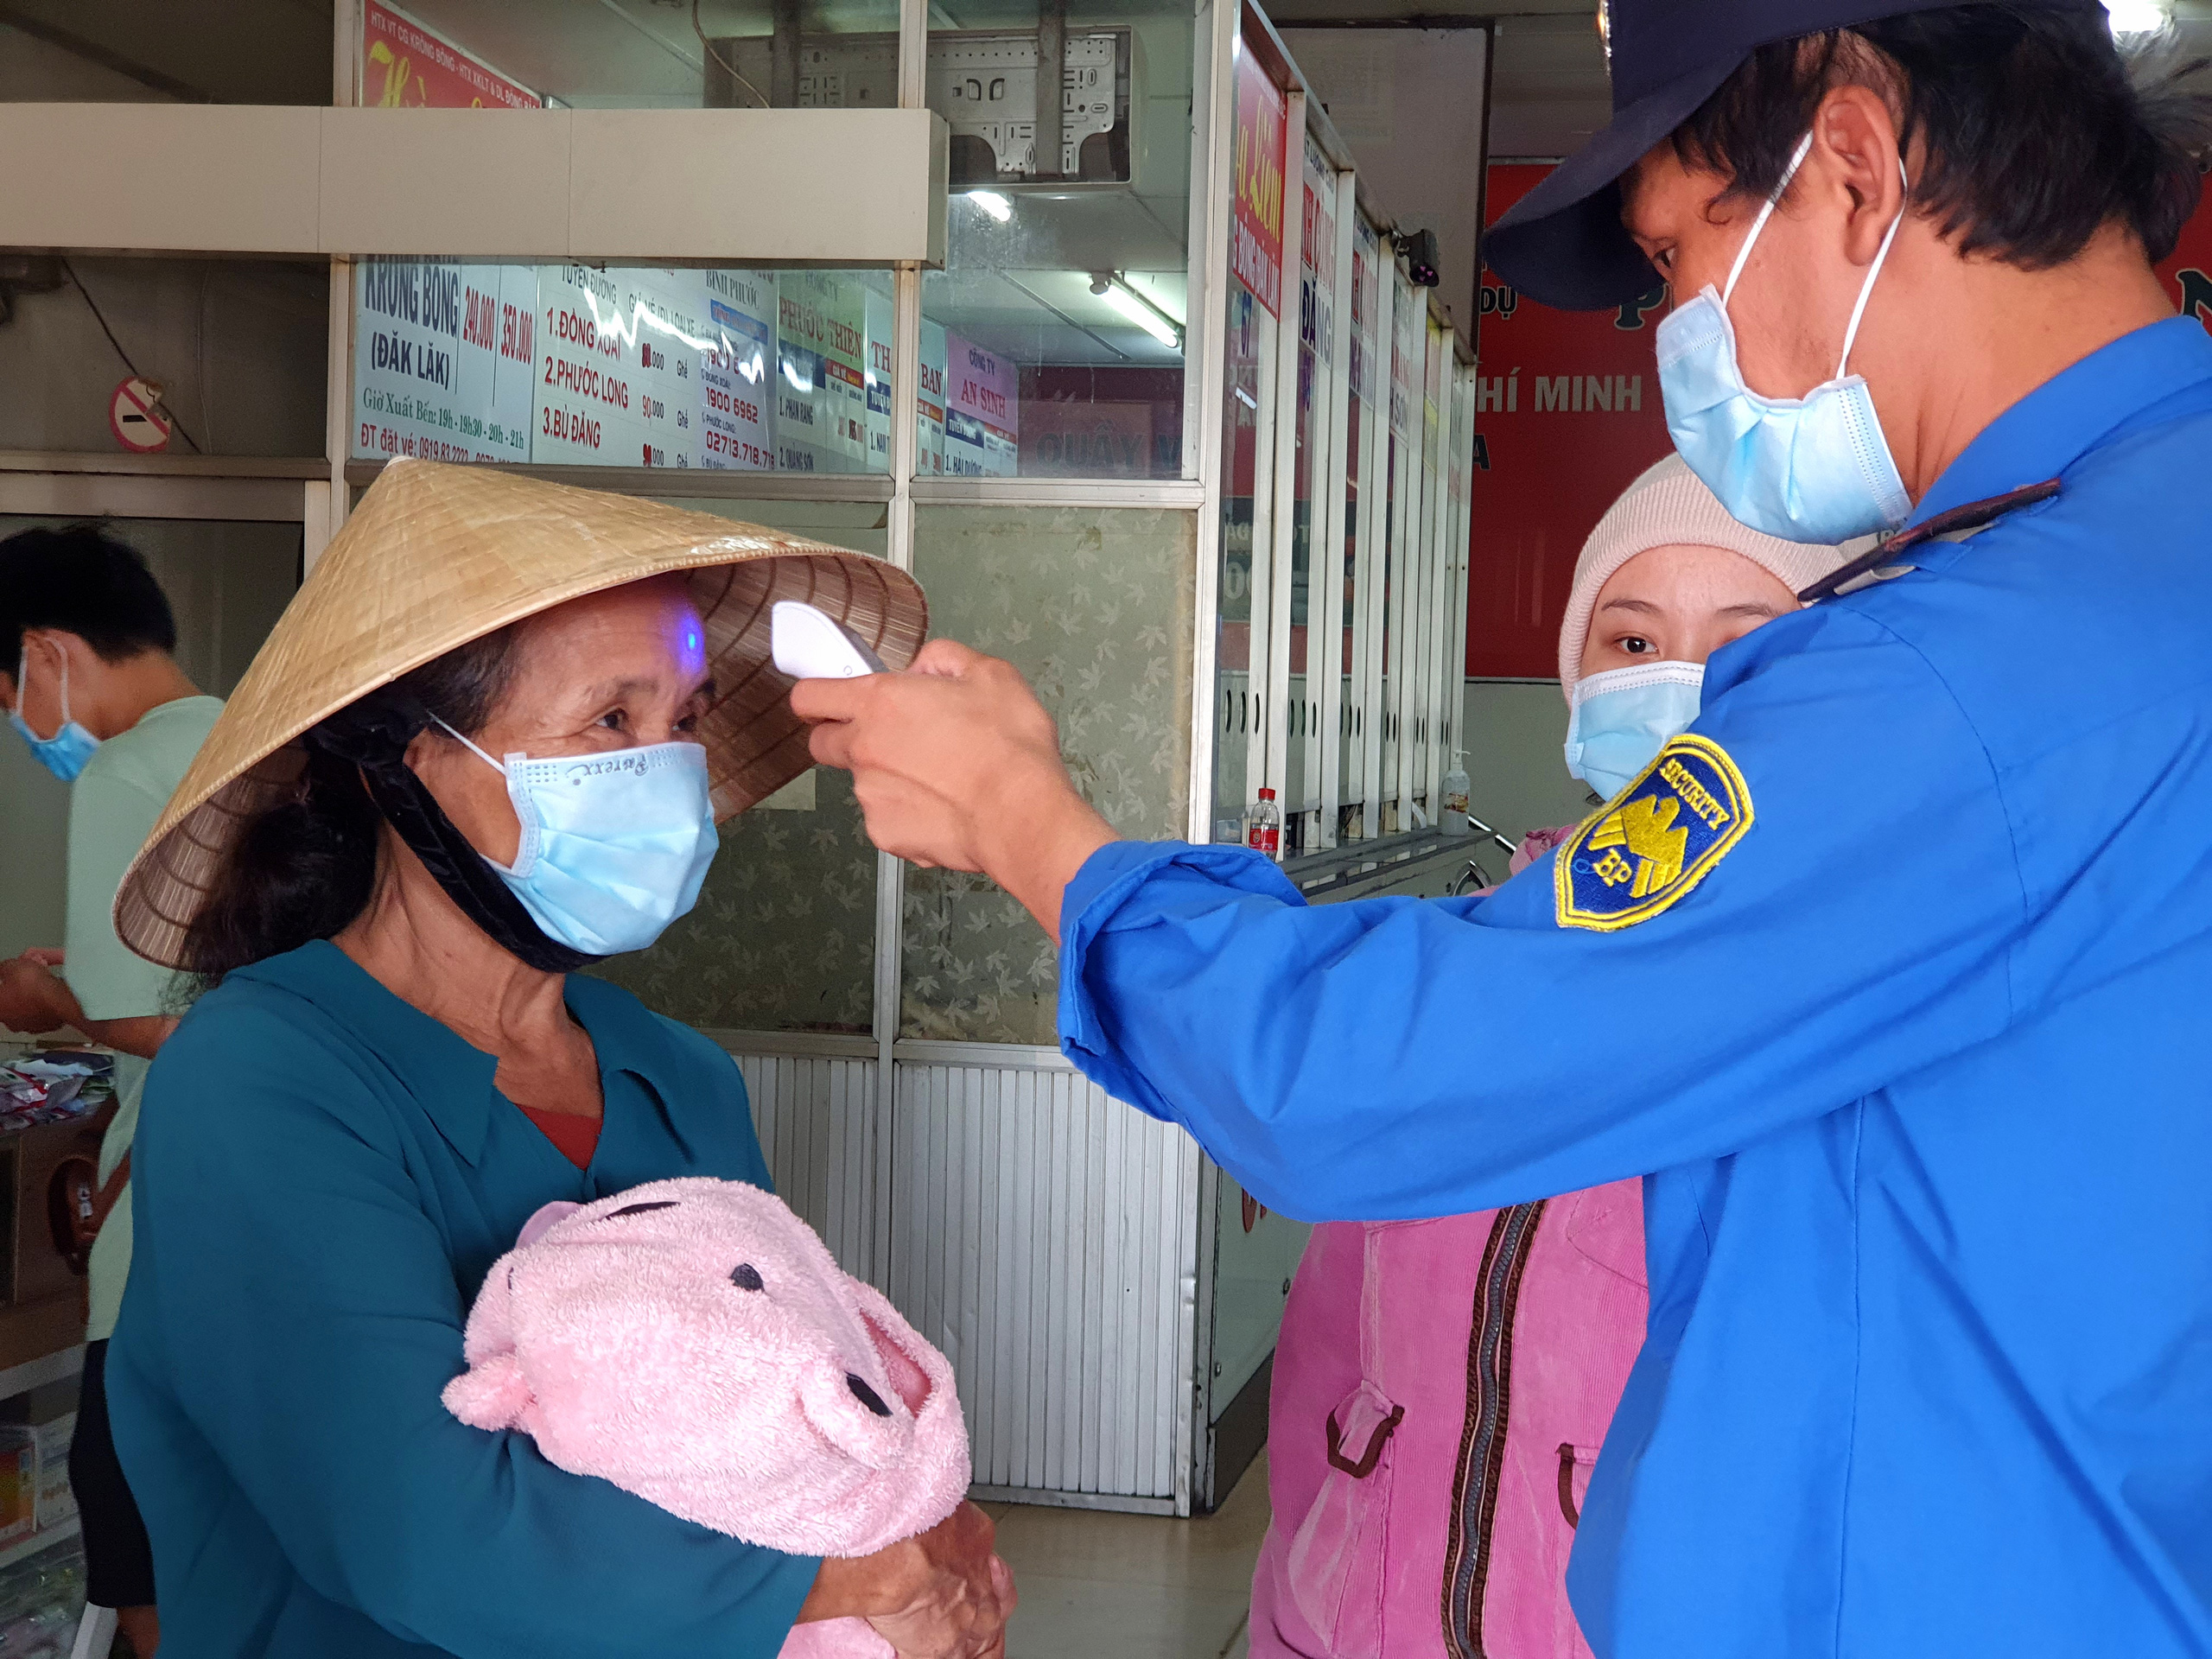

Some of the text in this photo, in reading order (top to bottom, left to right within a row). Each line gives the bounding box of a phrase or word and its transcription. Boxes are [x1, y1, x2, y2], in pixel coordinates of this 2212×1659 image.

[463, 285, 533, 366] 240.000 350.000
[969, 347, 986, 374] CÔNG
[544, 356, 599, 398] 2.PHƯỚC
[602, 374, 628, 409] LONG
[642, 395, 664, 419] 90.000
[706, 386, 758, 424] 1900 6962
[961, 378, 1007, 419] AN SINH
[1478, 366, 1642, 412] HÍ MINH
[361, 423, 377, 448] ĐT
[380, 427, 398, 457] đặt
[401, 432, 417, 456] vé:
[363, 387, 384, 410] Giờ
[385, 392, 413, 418] Xuất
[416, 400, 436, 424] Bến:
[438, 408, 454, 429] 19h
[460, 415, 482, 436] 19h30
[488, 423, 504, 444] 20h
[510, 429, 524, 449] 21h
[543, 404, 569, 440] 3.BÙ
[571, 410, 601, 448] ĐĂNG
[1660, 758, 1730, 830] SECURITY
[1592, 849, 1632, 887] BP
